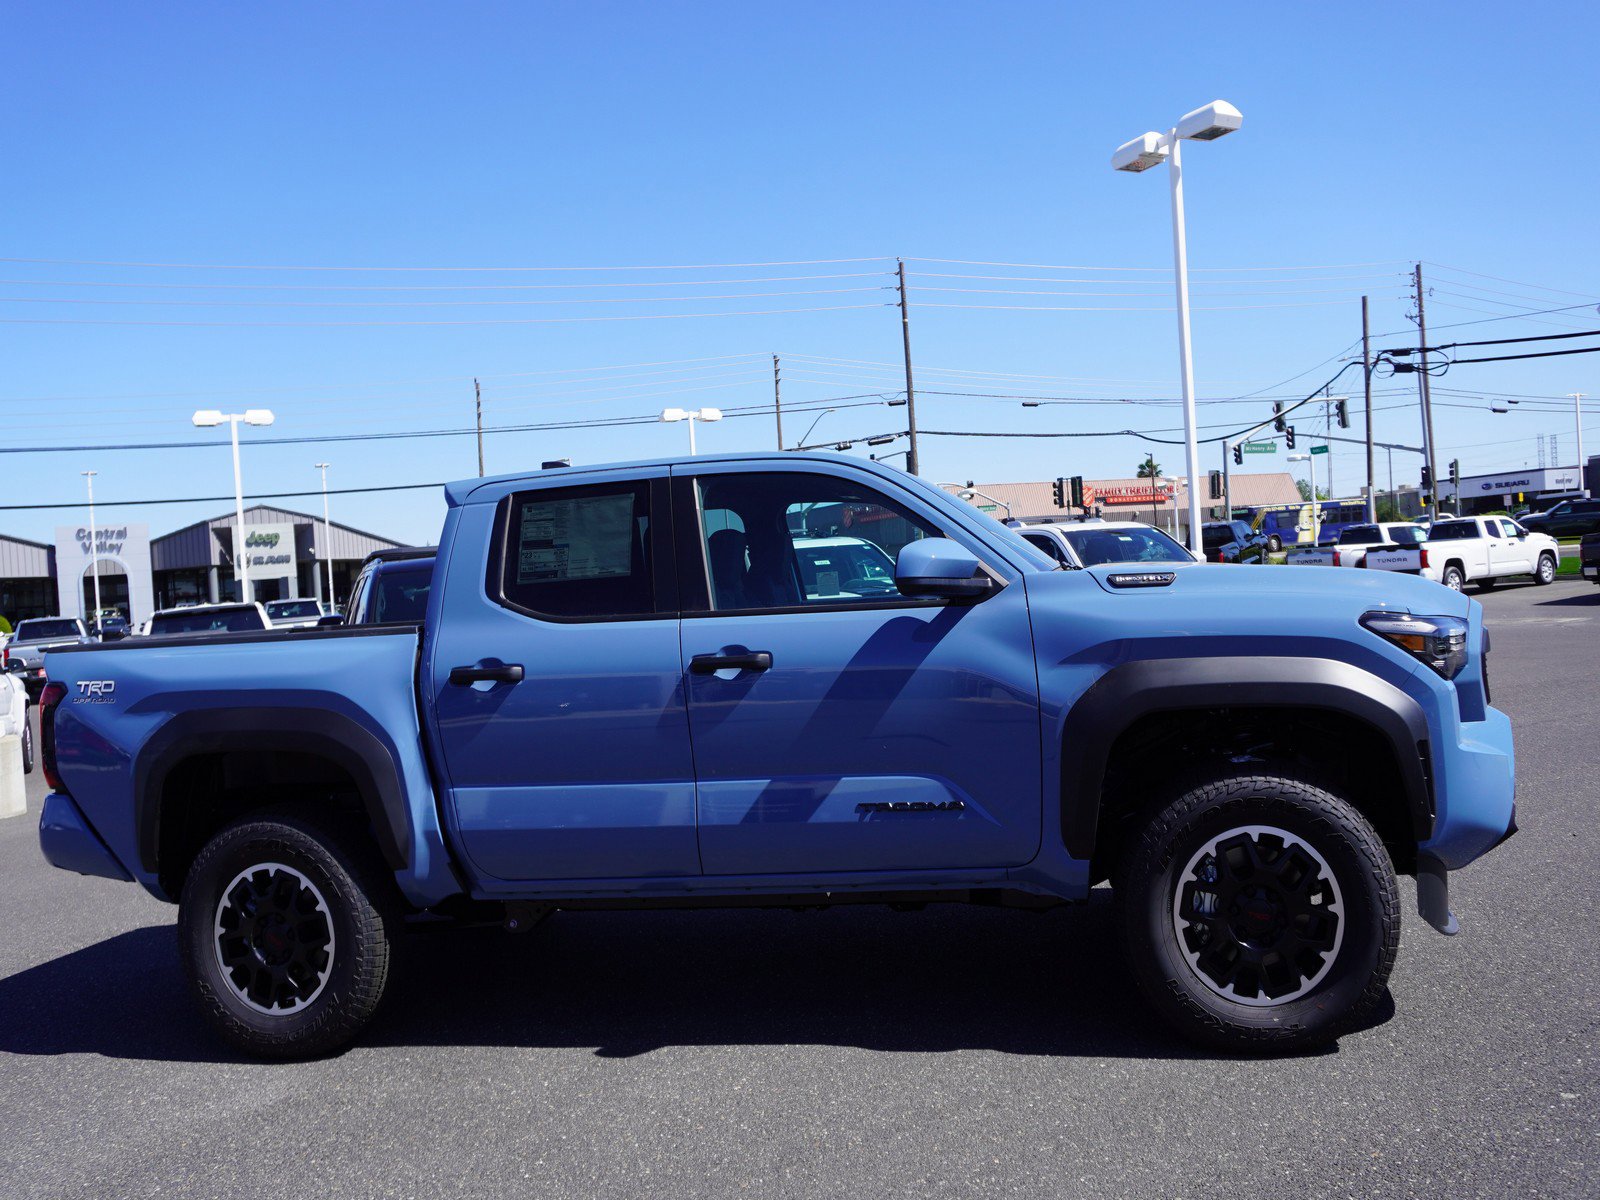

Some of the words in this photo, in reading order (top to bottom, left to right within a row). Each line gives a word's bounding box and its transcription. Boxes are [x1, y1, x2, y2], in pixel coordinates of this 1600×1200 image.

[1094, 487, 1121, 498] FAMILY
[1124, 485, 1152, 497] THRIFT
[1494, 479, 1530, 489] SUBARU
[245, 530, 281, 547] Jeep
[76, 680, 115, 697] TRD
